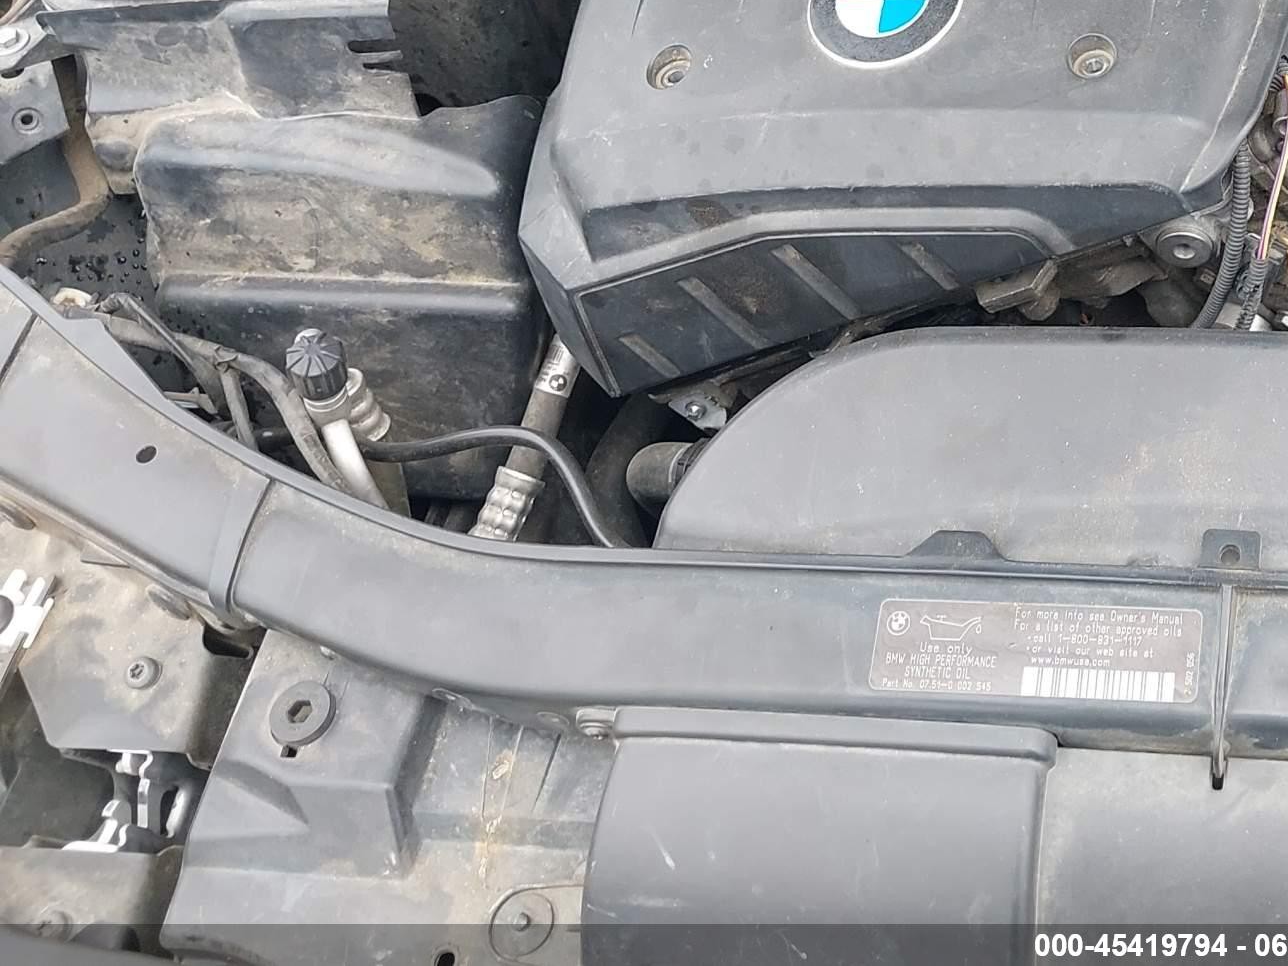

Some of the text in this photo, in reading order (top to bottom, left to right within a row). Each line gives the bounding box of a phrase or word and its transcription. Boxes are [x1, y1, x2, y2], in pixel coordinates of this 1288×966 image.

[1015, 607, 1031, 618] For
[1036, 610, 1059, 620] more
[1089, 612, 1105, 622] see
[1110, 610, 1146, 623] Owner's
[1151, 612, 1183, 625] Manual
[1014, 619, 1029, 631] For
[1047, 620, 1063, 632] list
[1069, 622, 1082, 633] of
[1085, 623, 1110, 634] other
[1116, 623, 1159, 636] approved
[1164, 625, 1182, 637] oils
[1033, 634, 1051, 643] call
[919, 641, 973, 657] Use only
[1032, 645, 1154, 659] or visit our web site at
[885, 652, 997, 668] BMW HIGH PERFORMANCE
[1031, 655, 1110, 667] www.bmwusa.com
[904, 665, 971, 680] SYNTHETIC OIL
[881, 677, 899, 688] Part
